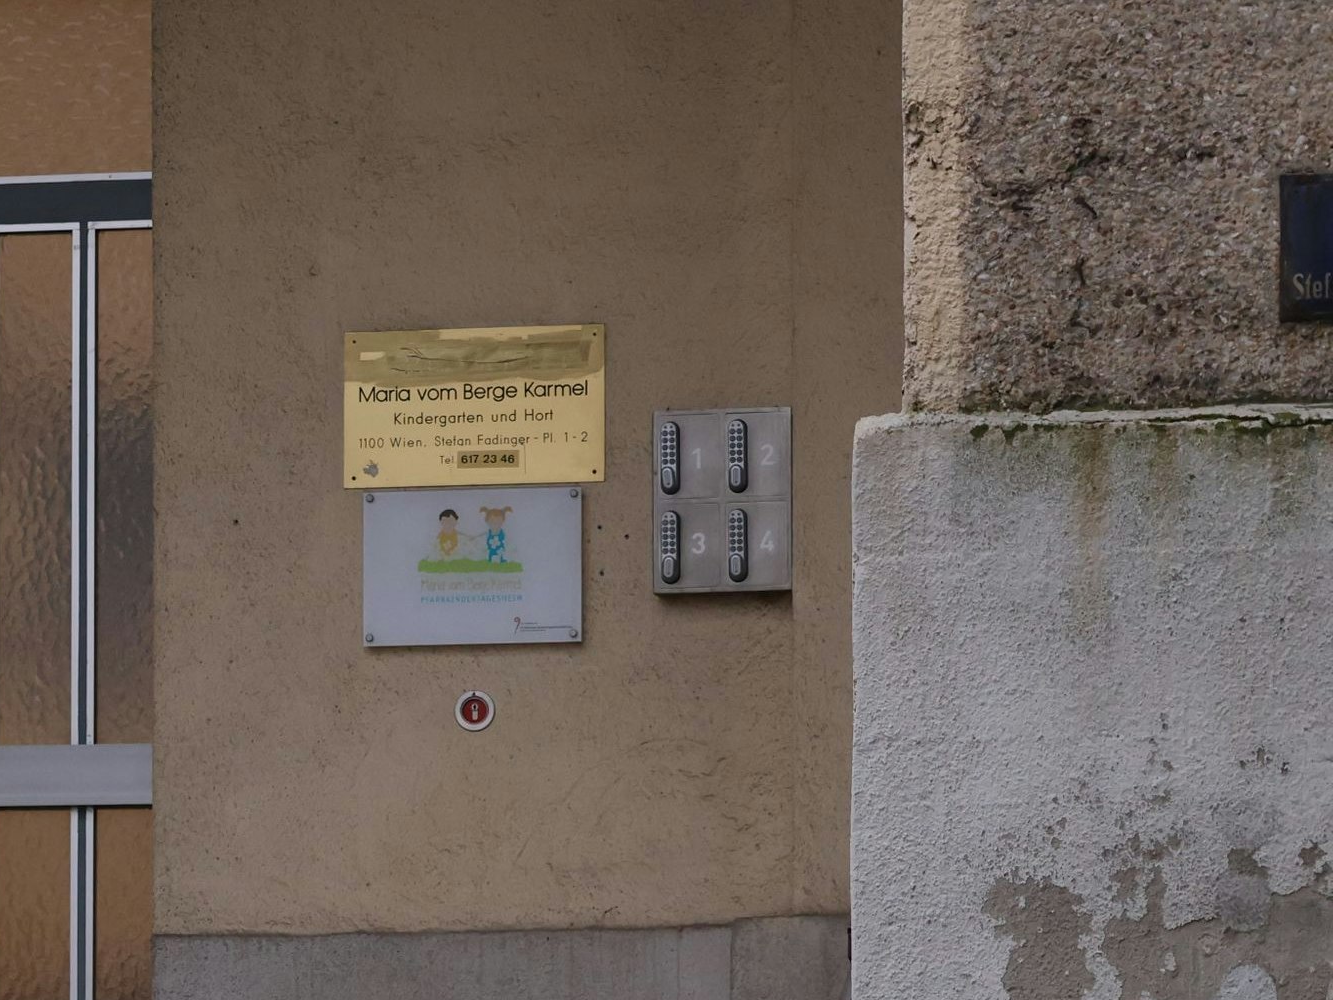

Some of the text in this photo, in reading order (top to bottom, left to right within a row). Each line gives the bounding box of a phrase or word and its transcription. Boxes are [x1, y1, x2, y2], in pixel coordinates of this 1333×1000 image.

[358, 380, 588, 403] Maria vom Berge Karmel
[393, 409, 554, 427] Kindergarten und Hort
[359, 437, 385, 449] 1100
[434, 435, 471, 447] Stefan
[477, 434, 530, 447] Fadinger
[460, 454, 479, 464] 617
[483, 454, 497, 464] 23
[500, 454, 515, 464] 46
[691, 447, 702, 470] 1
[760, 443, 776, 467] 2
[691, 531, 707, 555] 3
[759, 530, 775, 552] 4
